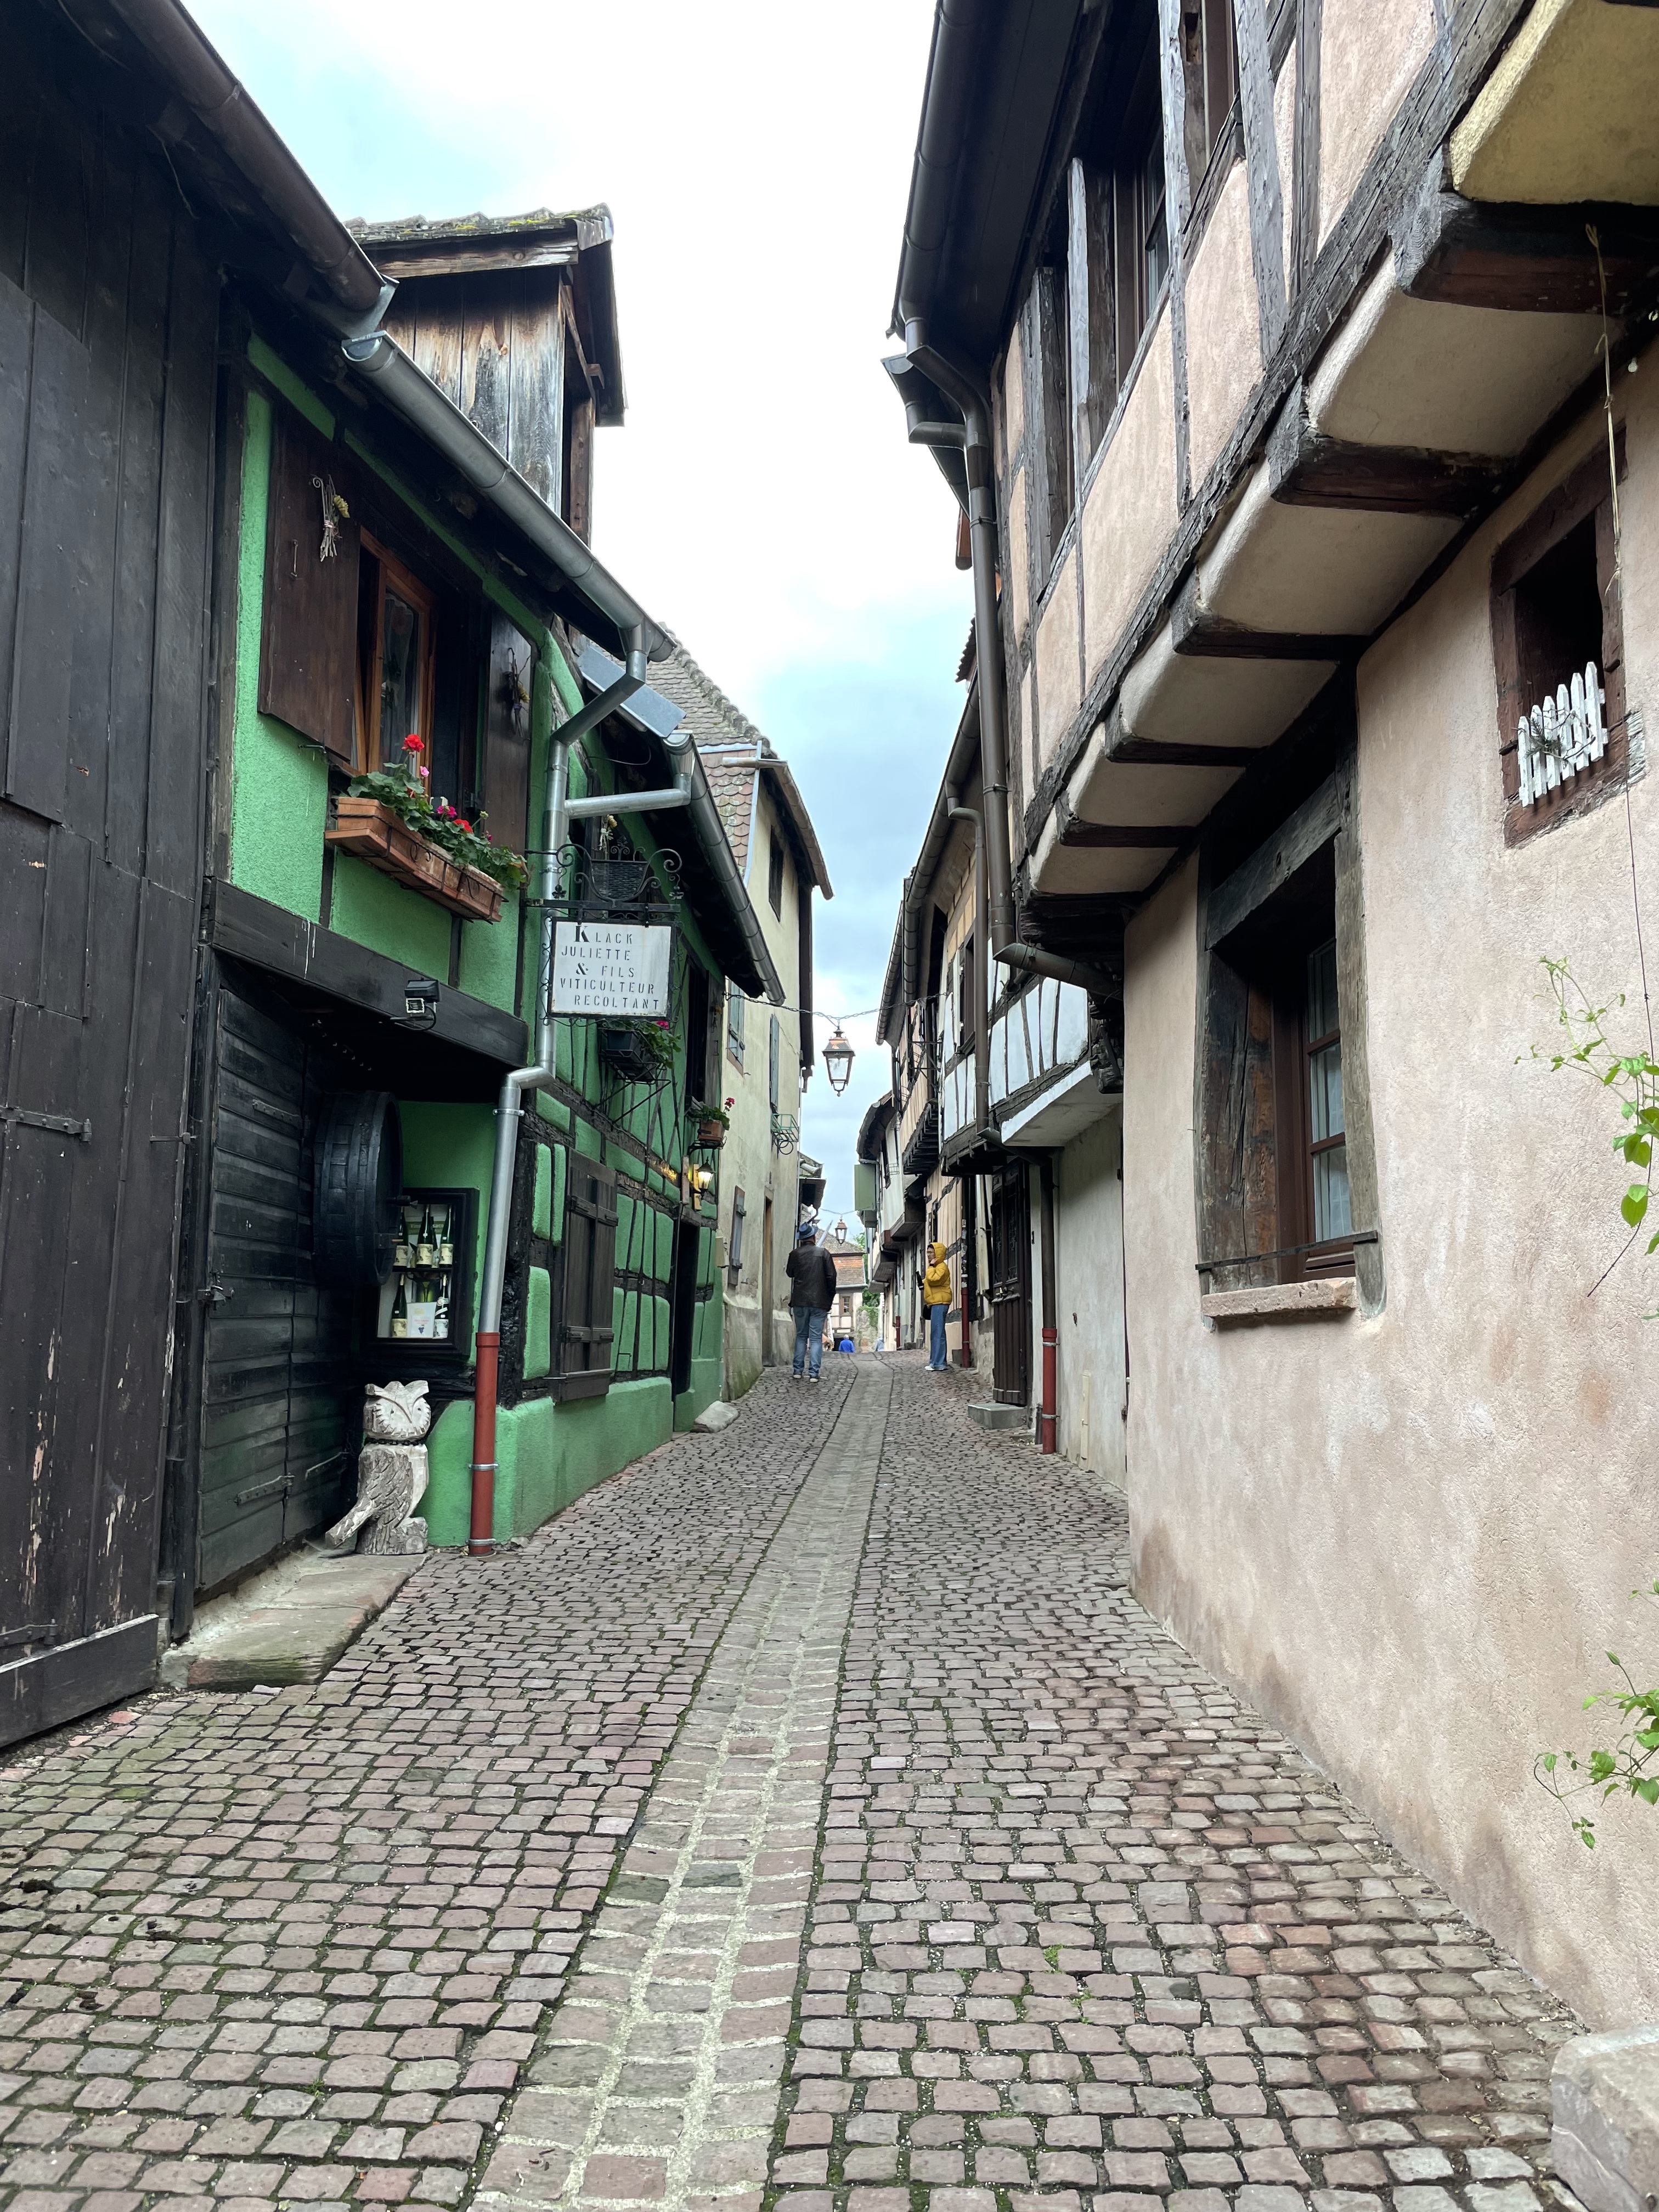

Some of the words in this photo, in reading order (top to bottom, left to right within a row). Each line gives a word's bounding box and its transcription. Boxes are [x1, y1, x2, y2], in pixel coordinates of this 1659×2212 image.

[574, 926, 633, 944] KLACK
[561, 946, 630, 960] JULIETTE
[576, 962, 589, 975] &
[602, 966, 634, 978] FILS
[561, 978, 654, 994] VITICULTEUR
[574, 995, 659, 1009] RECOLTANT
